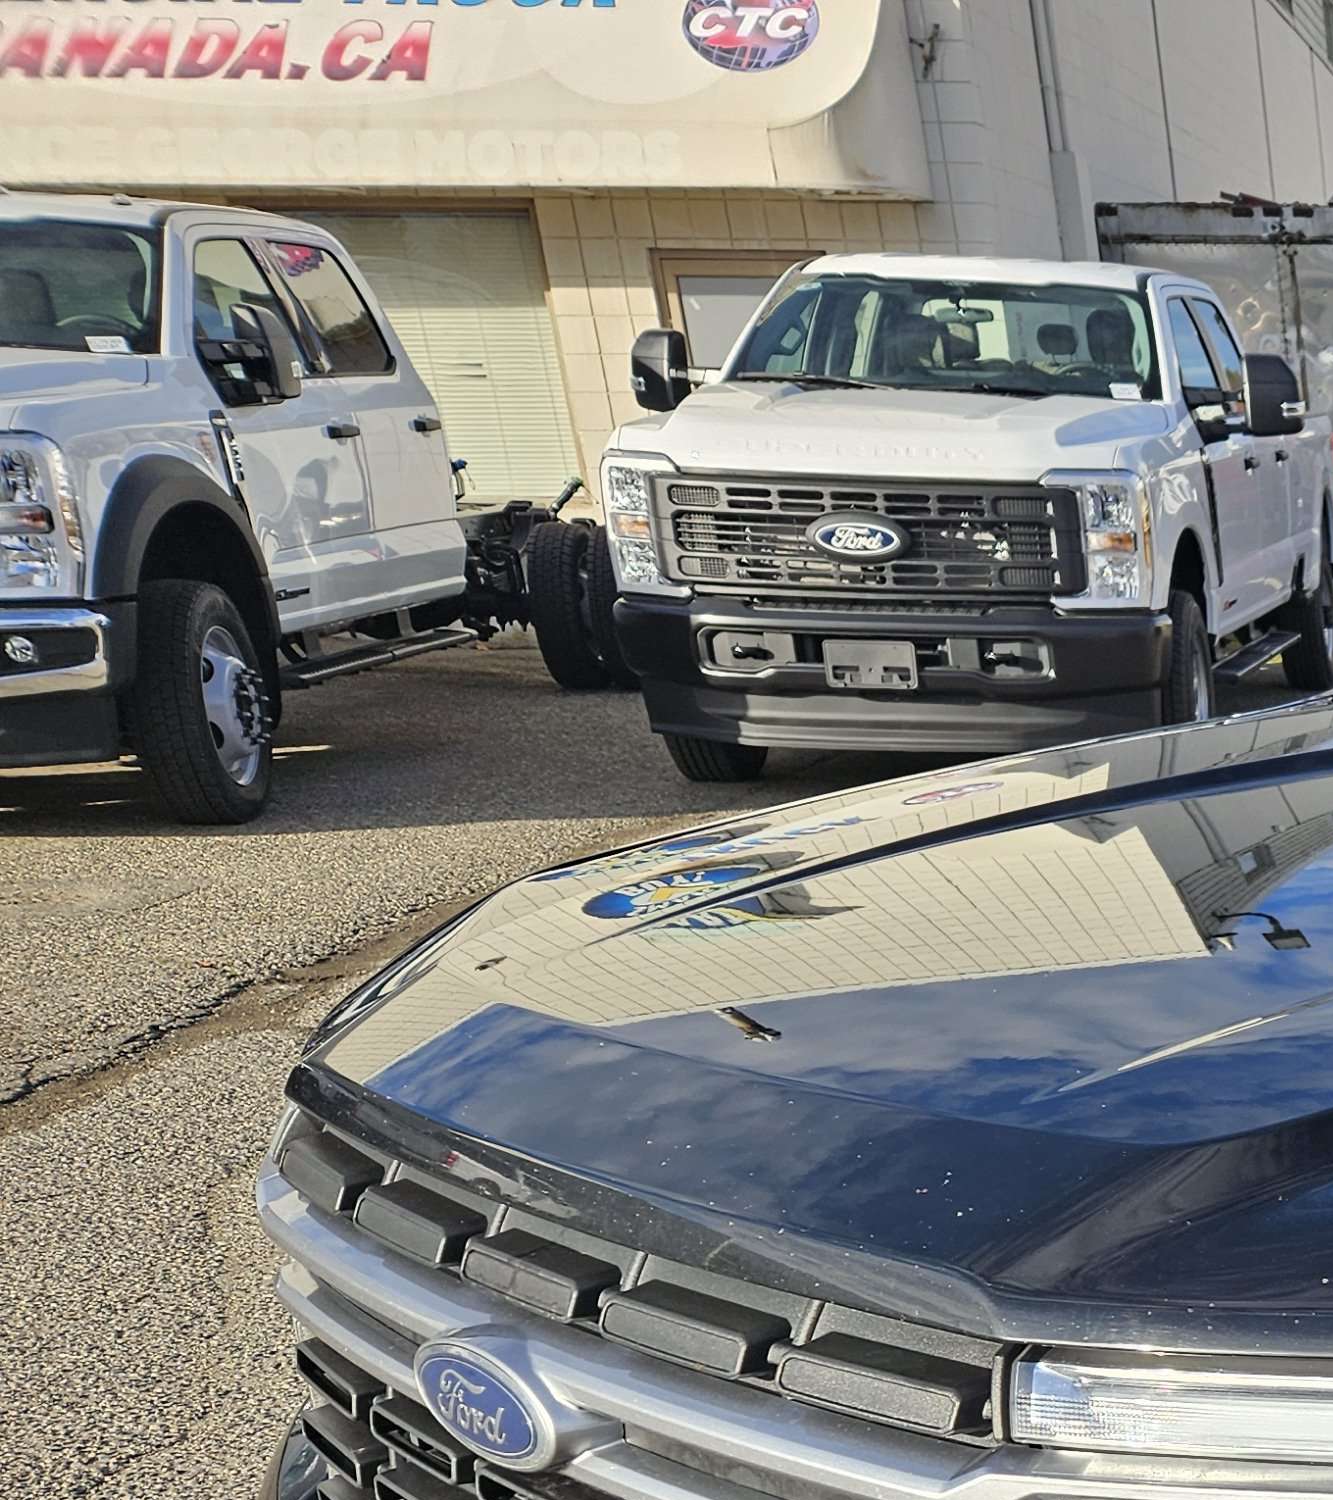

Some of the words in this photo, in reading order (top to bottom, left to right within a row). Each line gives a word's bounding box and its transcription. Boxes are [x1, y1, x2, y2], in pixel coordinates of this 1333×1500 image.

[688, 7, 809, 39] CTC
[0, 17, 434, 81] ANADA.CA
[830, 526, 884, 550] Ford
[437, 1368, 507, 1445] Ford
